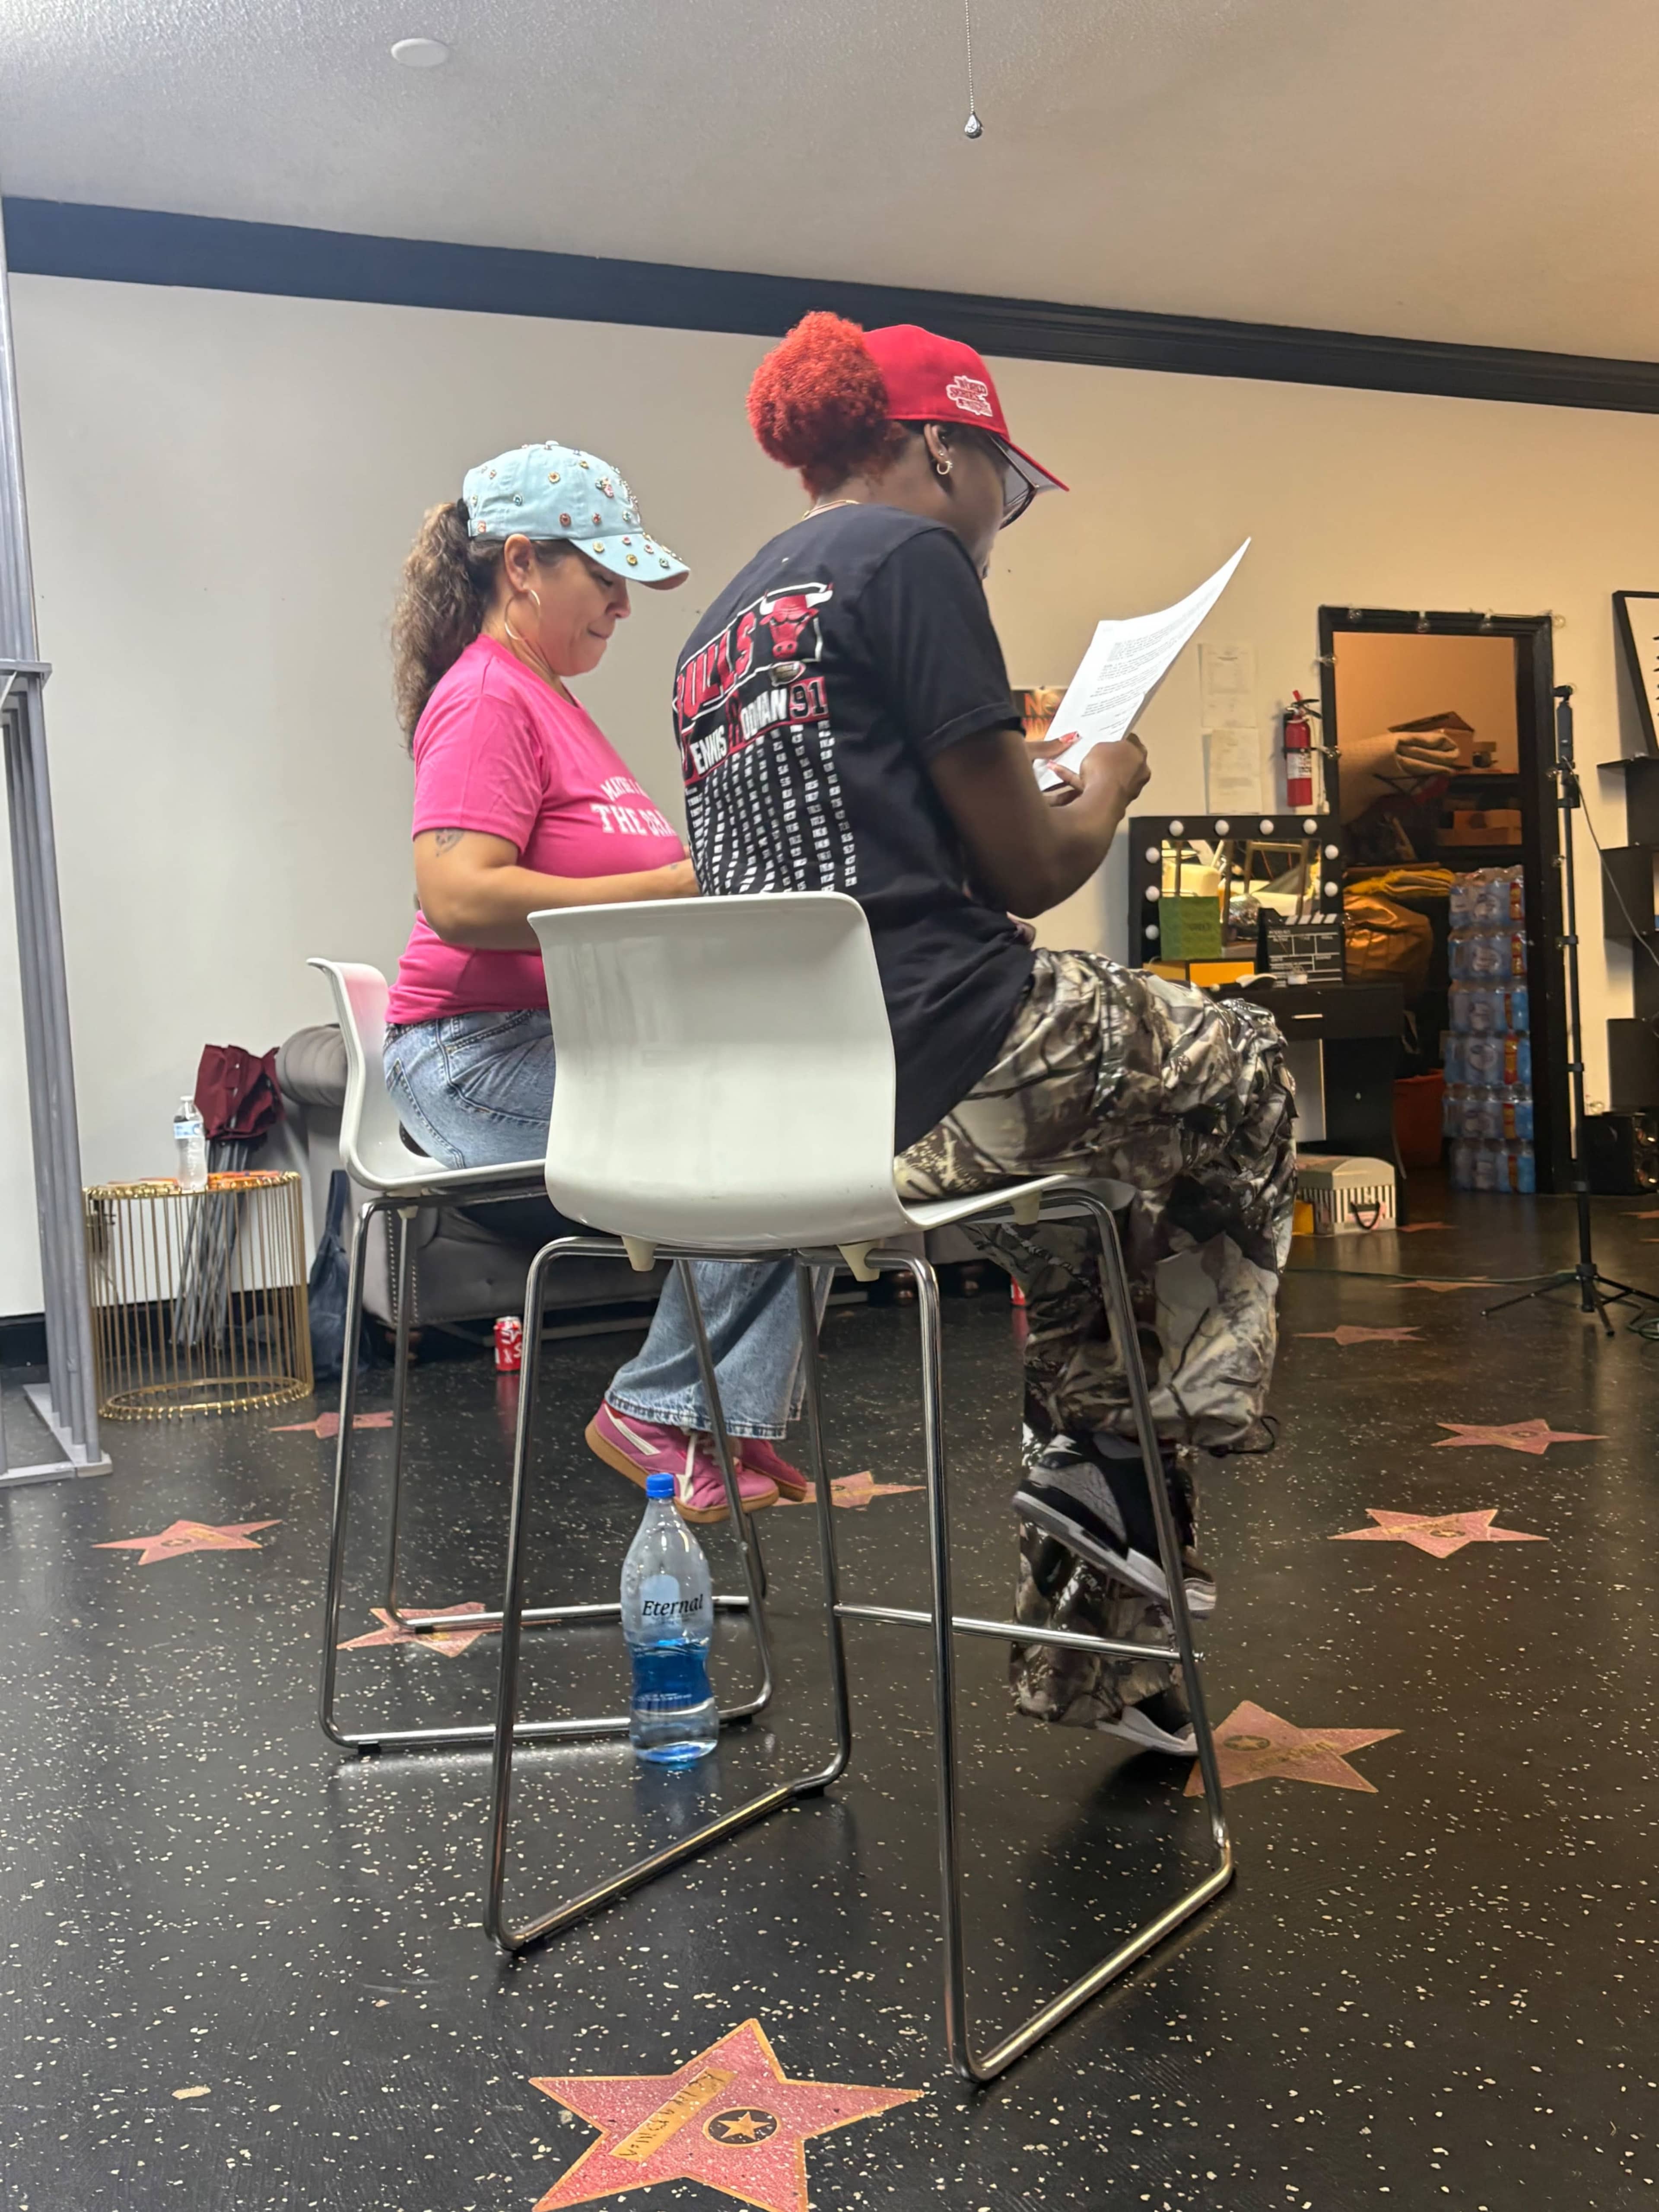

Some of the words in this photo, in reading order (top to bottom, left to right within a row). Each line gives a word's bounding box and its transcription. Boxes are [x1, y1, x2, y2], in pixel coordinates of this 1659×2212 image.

[790, 680, 828, 718] 91
[590, 803, 648, 837] THE
[642, 1594, 703, 1616] Eternal
